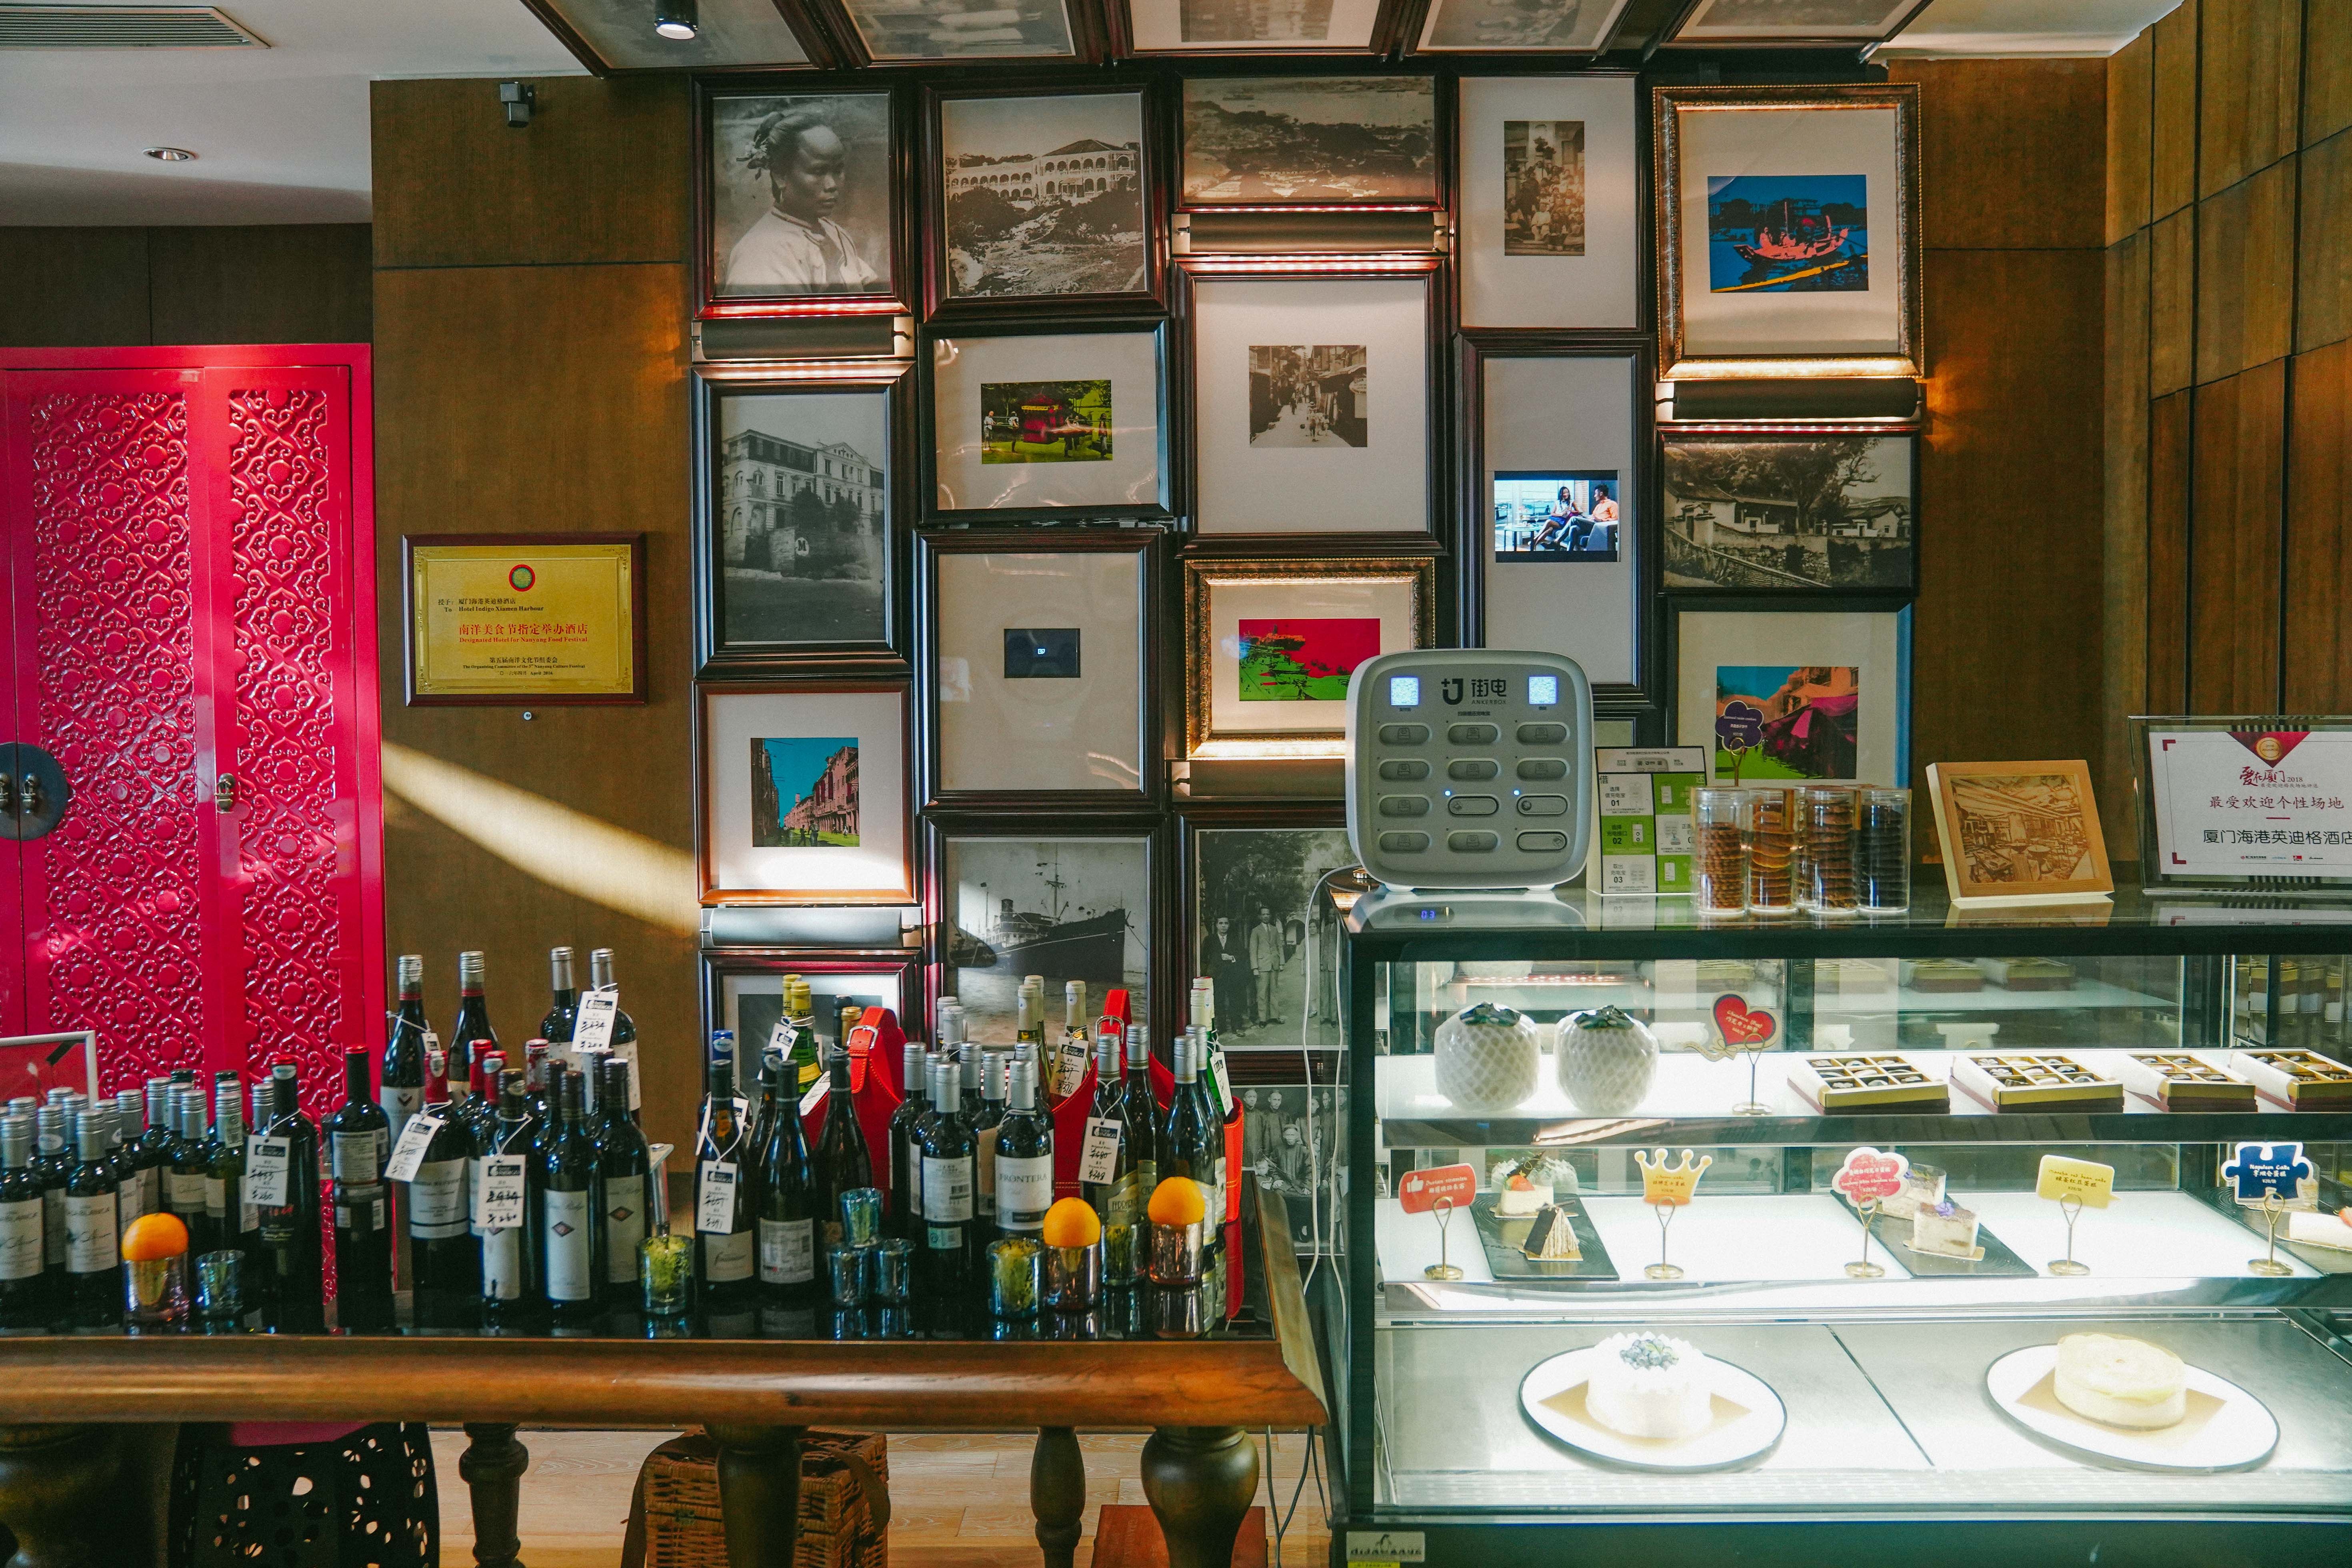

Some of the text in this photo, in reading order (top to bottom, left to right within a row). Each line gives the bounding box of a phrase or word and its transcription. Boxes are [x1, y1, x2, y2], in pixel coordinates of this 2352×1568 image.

[459, 623, 588, 635] 南洋美食节指定举办酒店
[1471, 678, 1507, 698] 街电
[1599, 774, 1608, 784] 借
[2209, 796, 2345, 810] 最受欢迎个性场地
[2203, 830, 2352, 845] 厦门海港英迪格酒店
[998, 1174, 1049, 1183] FRONTERA
